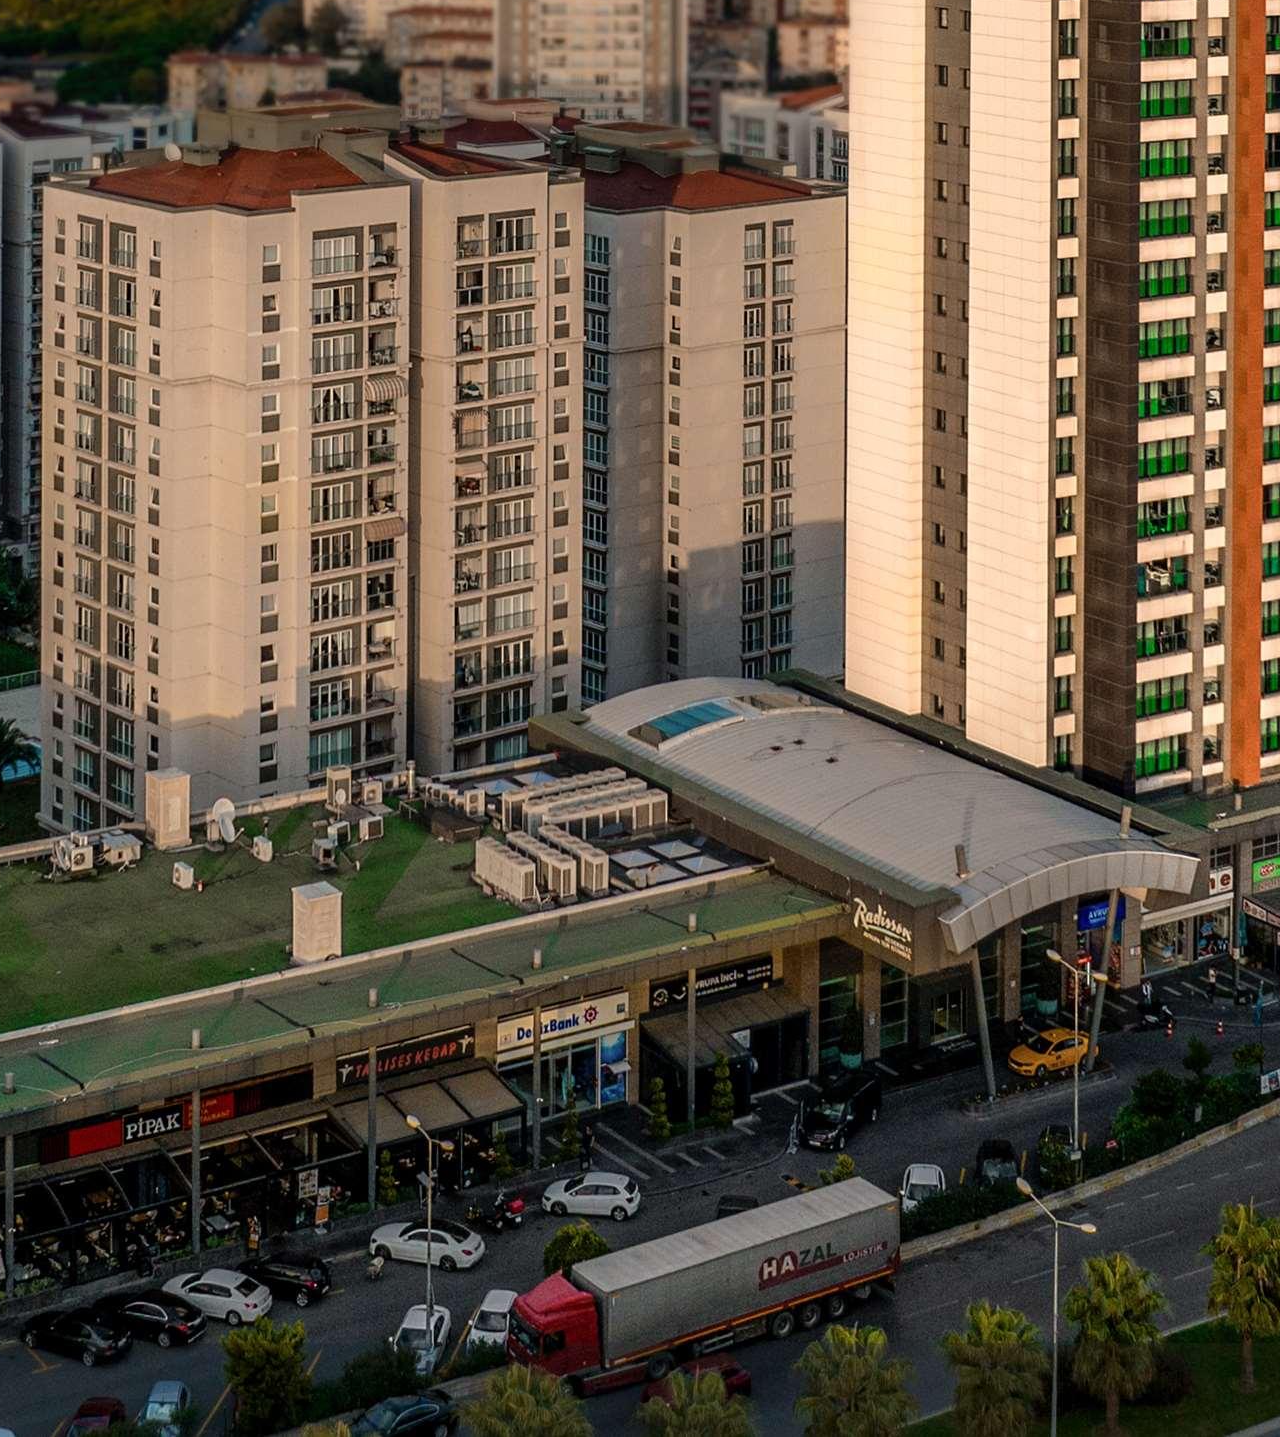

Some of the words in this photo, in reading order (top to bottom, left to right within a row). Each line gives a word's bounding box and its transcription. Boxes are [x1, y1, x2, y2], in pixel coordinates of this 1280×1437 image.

[853, 897, 912, 943] Radisson
[690, 975, 721, 991] VRUPA
[517, 1014, 580, 1041] DeizBank
[354, 1051, 412, 1079] TALISES
[125, 1112, 181, 1140] PİPAK
